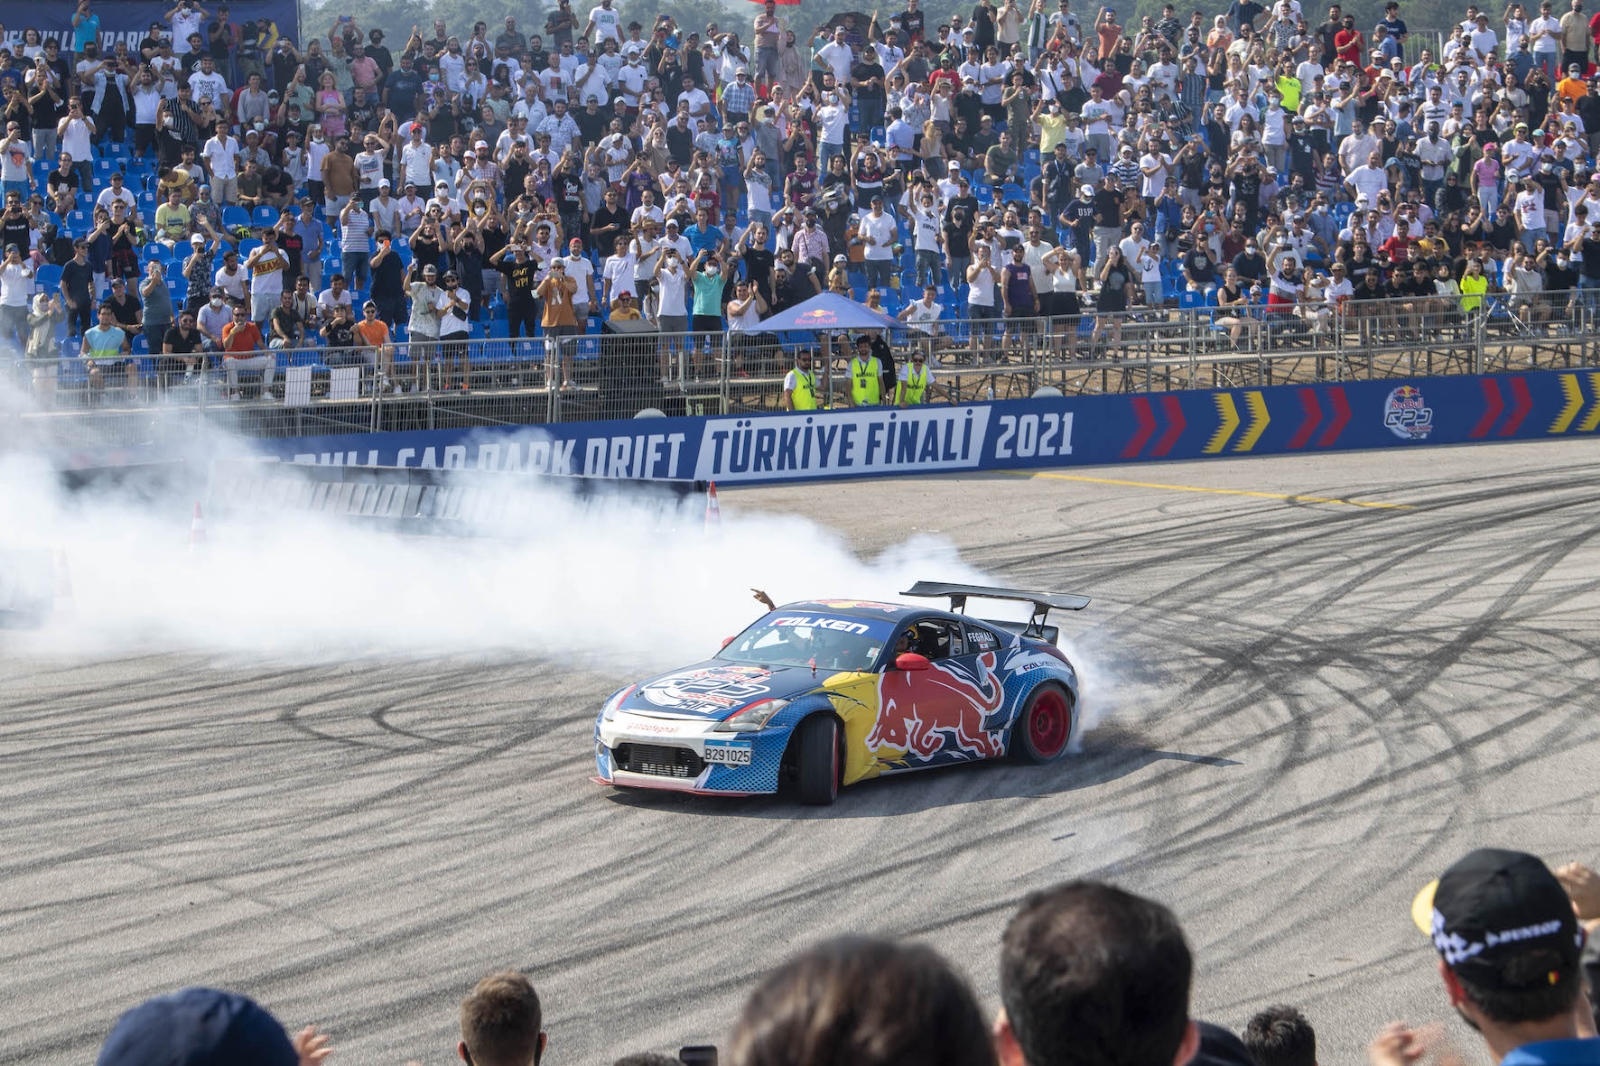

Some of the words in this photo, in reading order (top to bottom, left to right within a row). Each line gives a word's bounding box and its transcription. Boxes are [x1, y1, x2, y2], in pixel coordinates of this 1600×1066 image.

[584, 433, 686, 478] DRIFT
[711, 416, 857, 475] TÜRKİYE
[864, 408, 974, 466] FİNALİ
[995, 412, 1074, 459] 2021
[768, 617, 870, 635] FALKEN
[967, 632, 995, 642] FEGHALI
[705, 748, 750, 763] B291025
